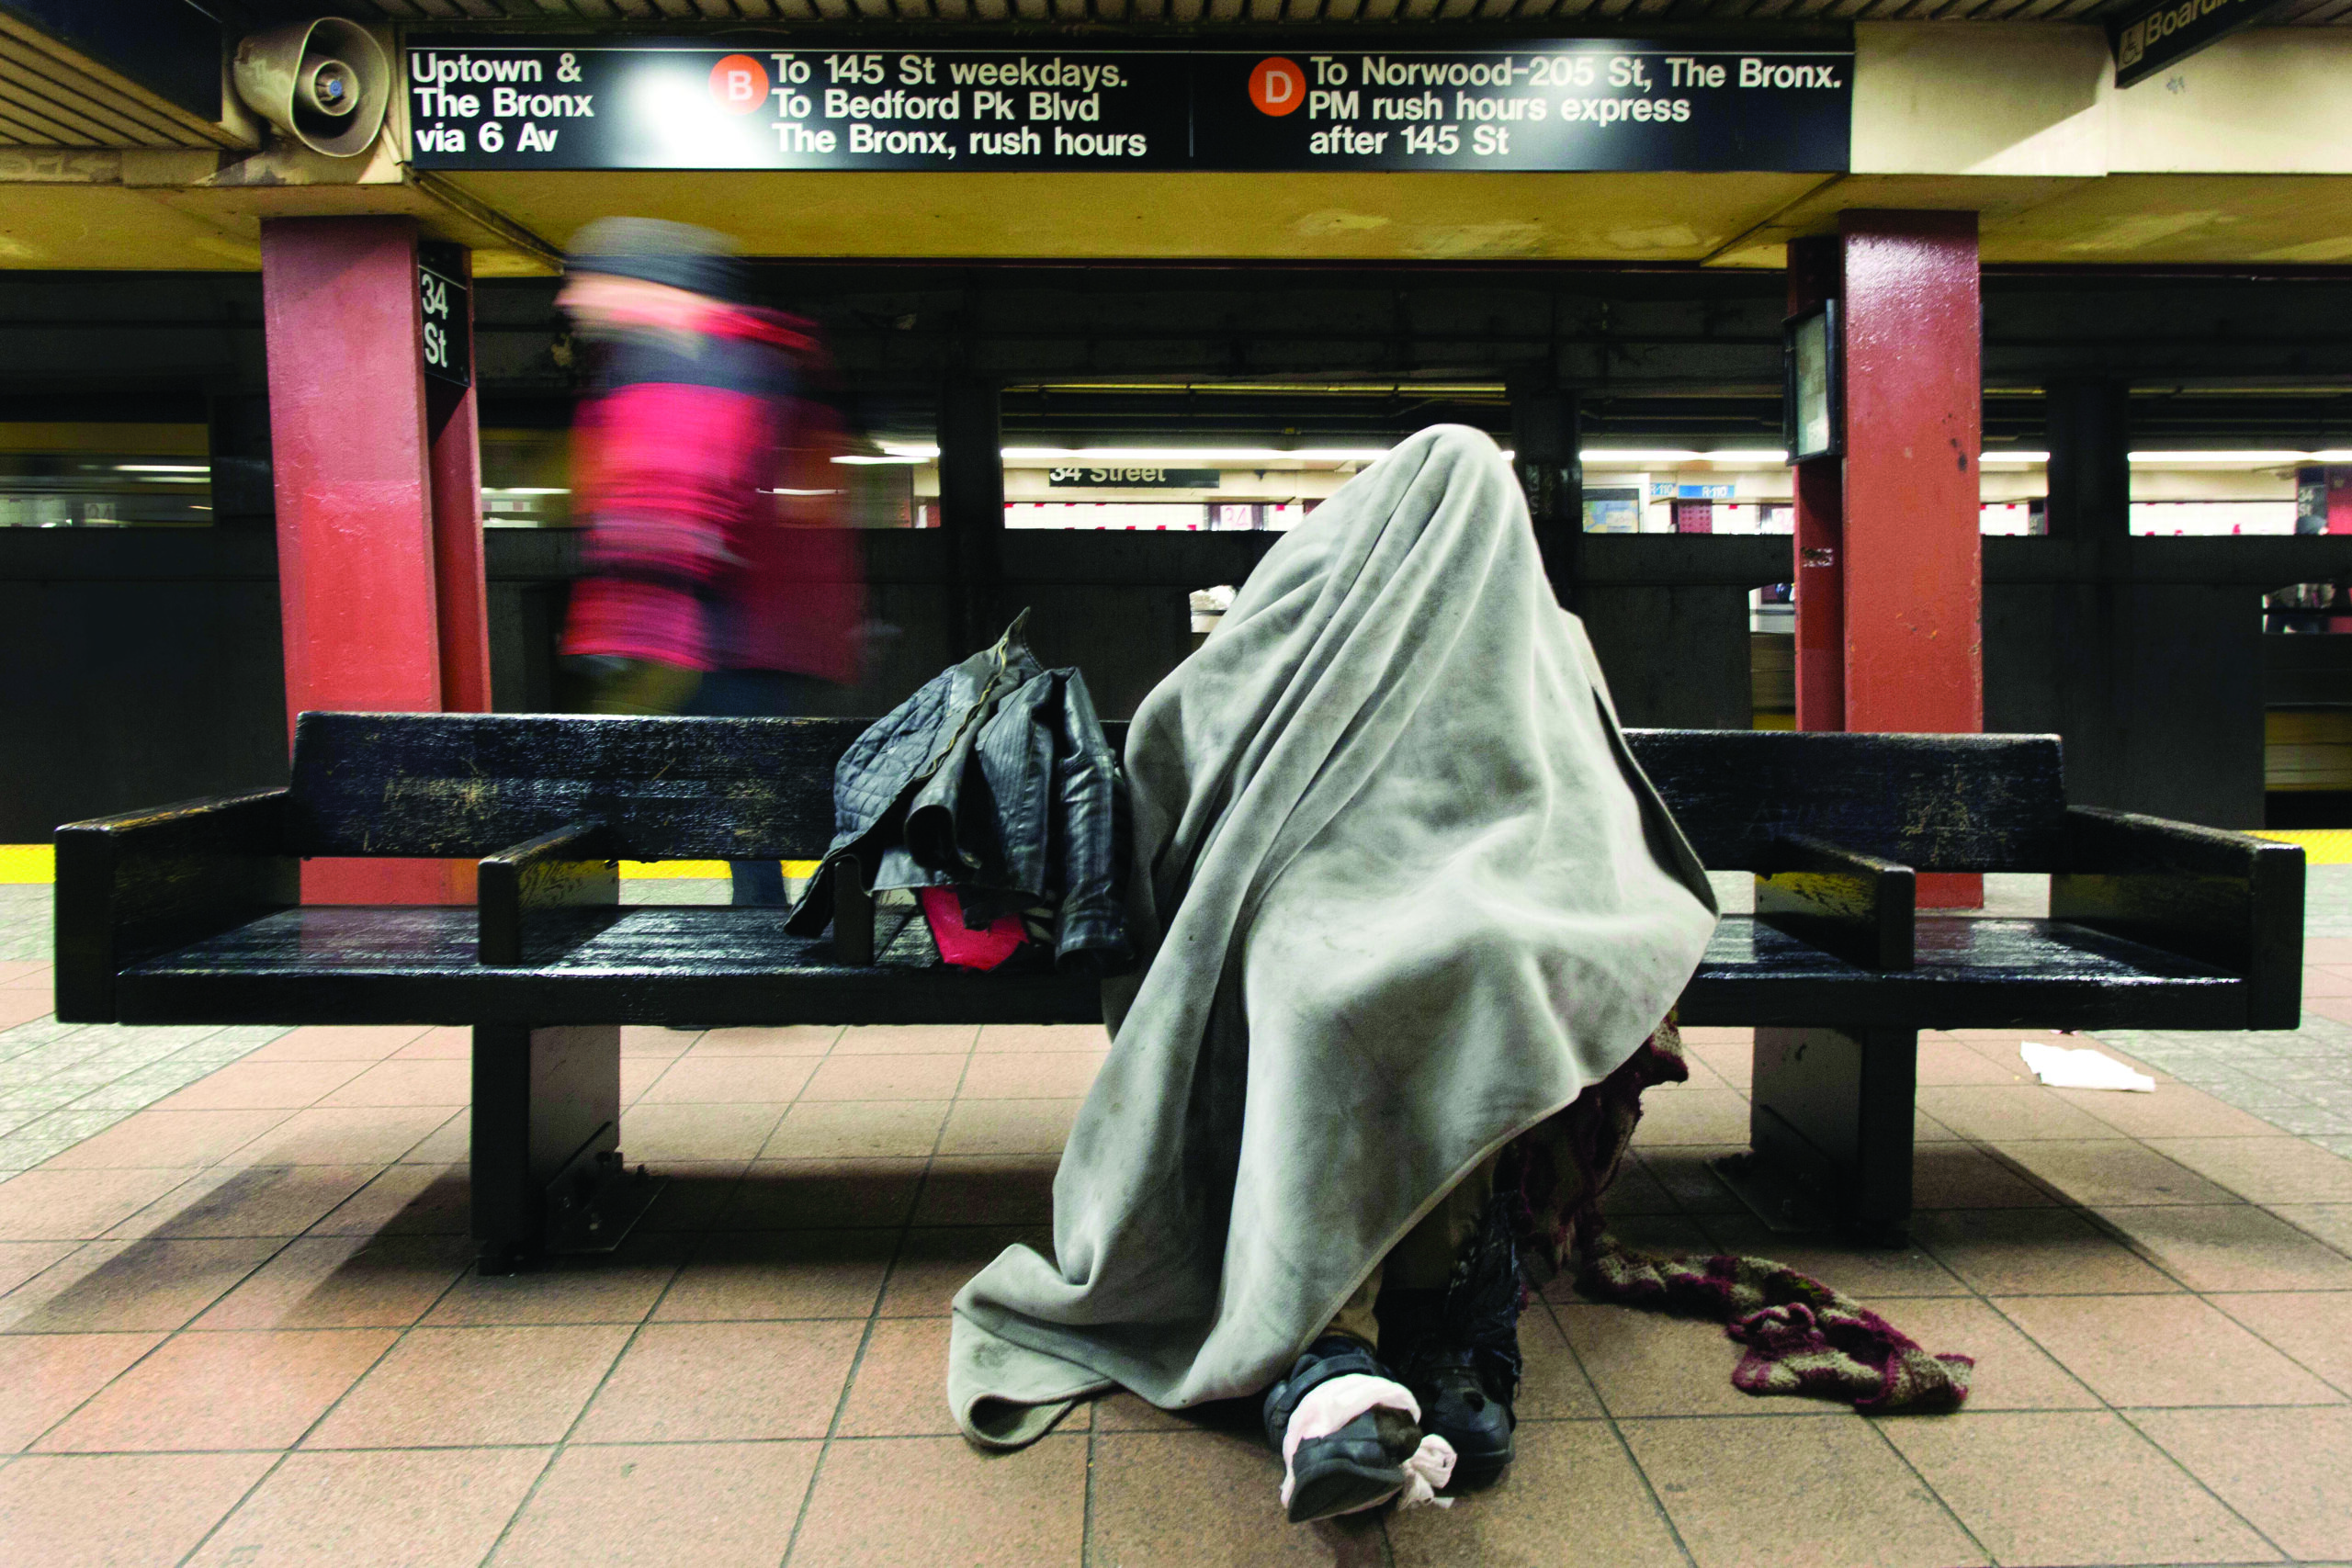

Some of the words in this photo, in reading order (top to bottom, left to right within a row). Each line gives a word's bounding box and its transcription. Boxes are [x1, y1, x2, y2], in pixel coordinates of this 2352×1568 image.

[412, 52, 542, 87] Uptown
[557, 52, 582, 83] &
[726, 70, 753, 100] B
[771, 54, 810, 85] To
[824, 54, 884, 84] 145
[899, 55, 936, 85] St
[950, 57, 1128, 93] weekdays.
[1310, 56, 1348, 85] To
[1363, 56, 1593, 87] Norwood-205
[1607, 58, 1652, 92] St,
[1665, 58, 1725, 87] The
[1738, 59, 1841, 89] Bronx.
[413, 87, 481, 118] The
[493, 87, 594, 118] Bronx
[1265, 71, 1292, 103] D
[772, 88, 811, 118] To
[825, 89, 959, 120] Bedford
[974, 91, 1014, 120] Pk
[1029, 91, 1100, 121] Blvd
[1309, 92, 1359, 119] PM
[1372, 91, 1442, 120] rush
[1455, 91, 1546, 121] hours
[1560, 95, 1690, 126] express
[415, 122, 466, 152] via
[479, 121, 504, 152] 6
[516, 121, 559, 152] Av
[772, 123, 836, 154] The
[850, 124, 956, 160] Bronx,
[969, 127, 1040, 155] rush
[1055, 127, 1147, 157] hours
[1309, 125, 1388, 154] after
[1399, 126, 1459, 154] 145
[1472, 125, 1509, 154] St
[422, 274, 448, 320] 34
[424, 322, 447, 367] St
[1049, 468, 1082, 481] 34
[1091, 468, 1166, 482] Street
[1225, 506, 1248, 528] 34
